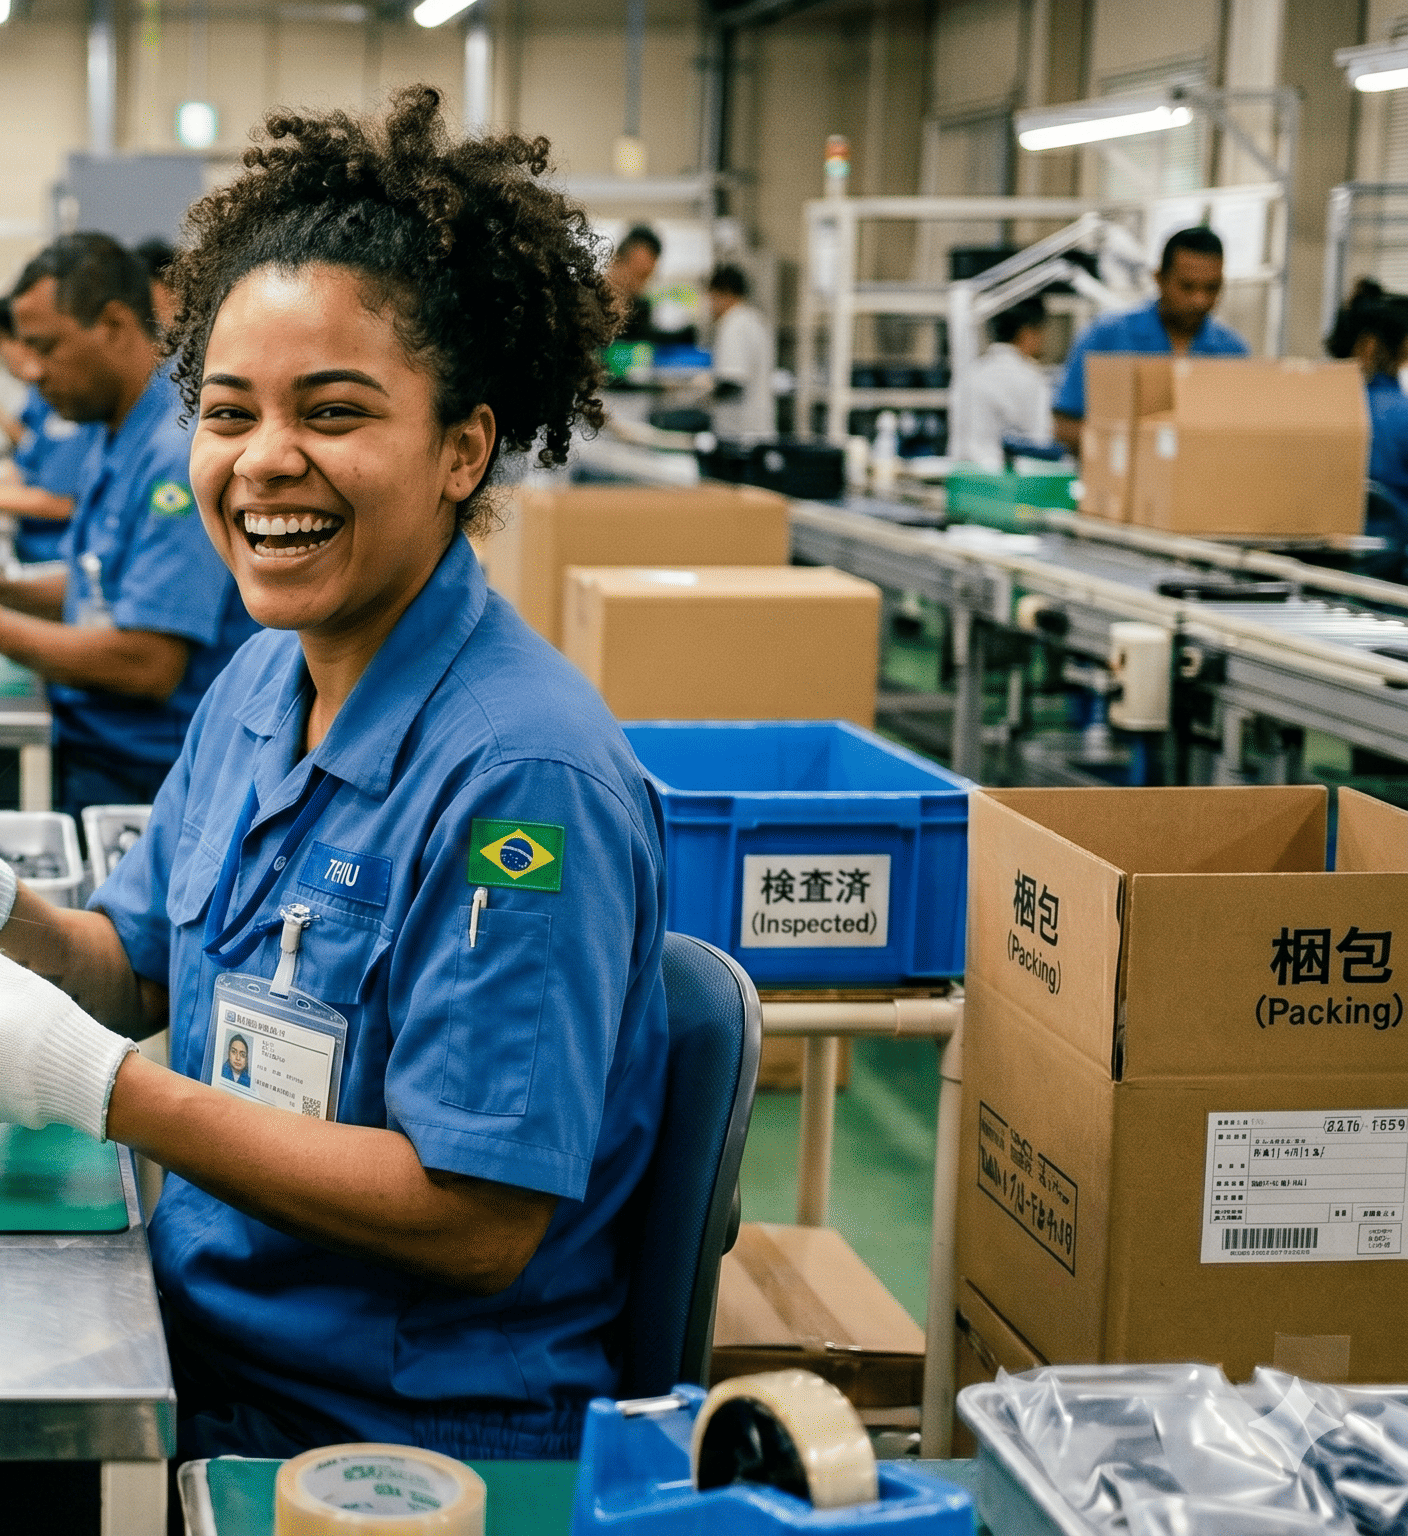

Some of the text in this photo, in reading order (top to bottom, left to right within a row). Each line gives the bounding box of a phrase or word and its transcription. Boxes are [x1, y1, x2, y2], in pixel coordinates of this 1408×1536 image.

[761, 868, 871, 905] 検査済
[1013, 868, 1059, 947] 梱包
[751, 910, 878, 938] (Inspected)
[1007, 929, 1061, 996] (Packing)
[1269, 926, 1393, 986] 梱包
[1255, 992, 1404, 1031] (Packing)
